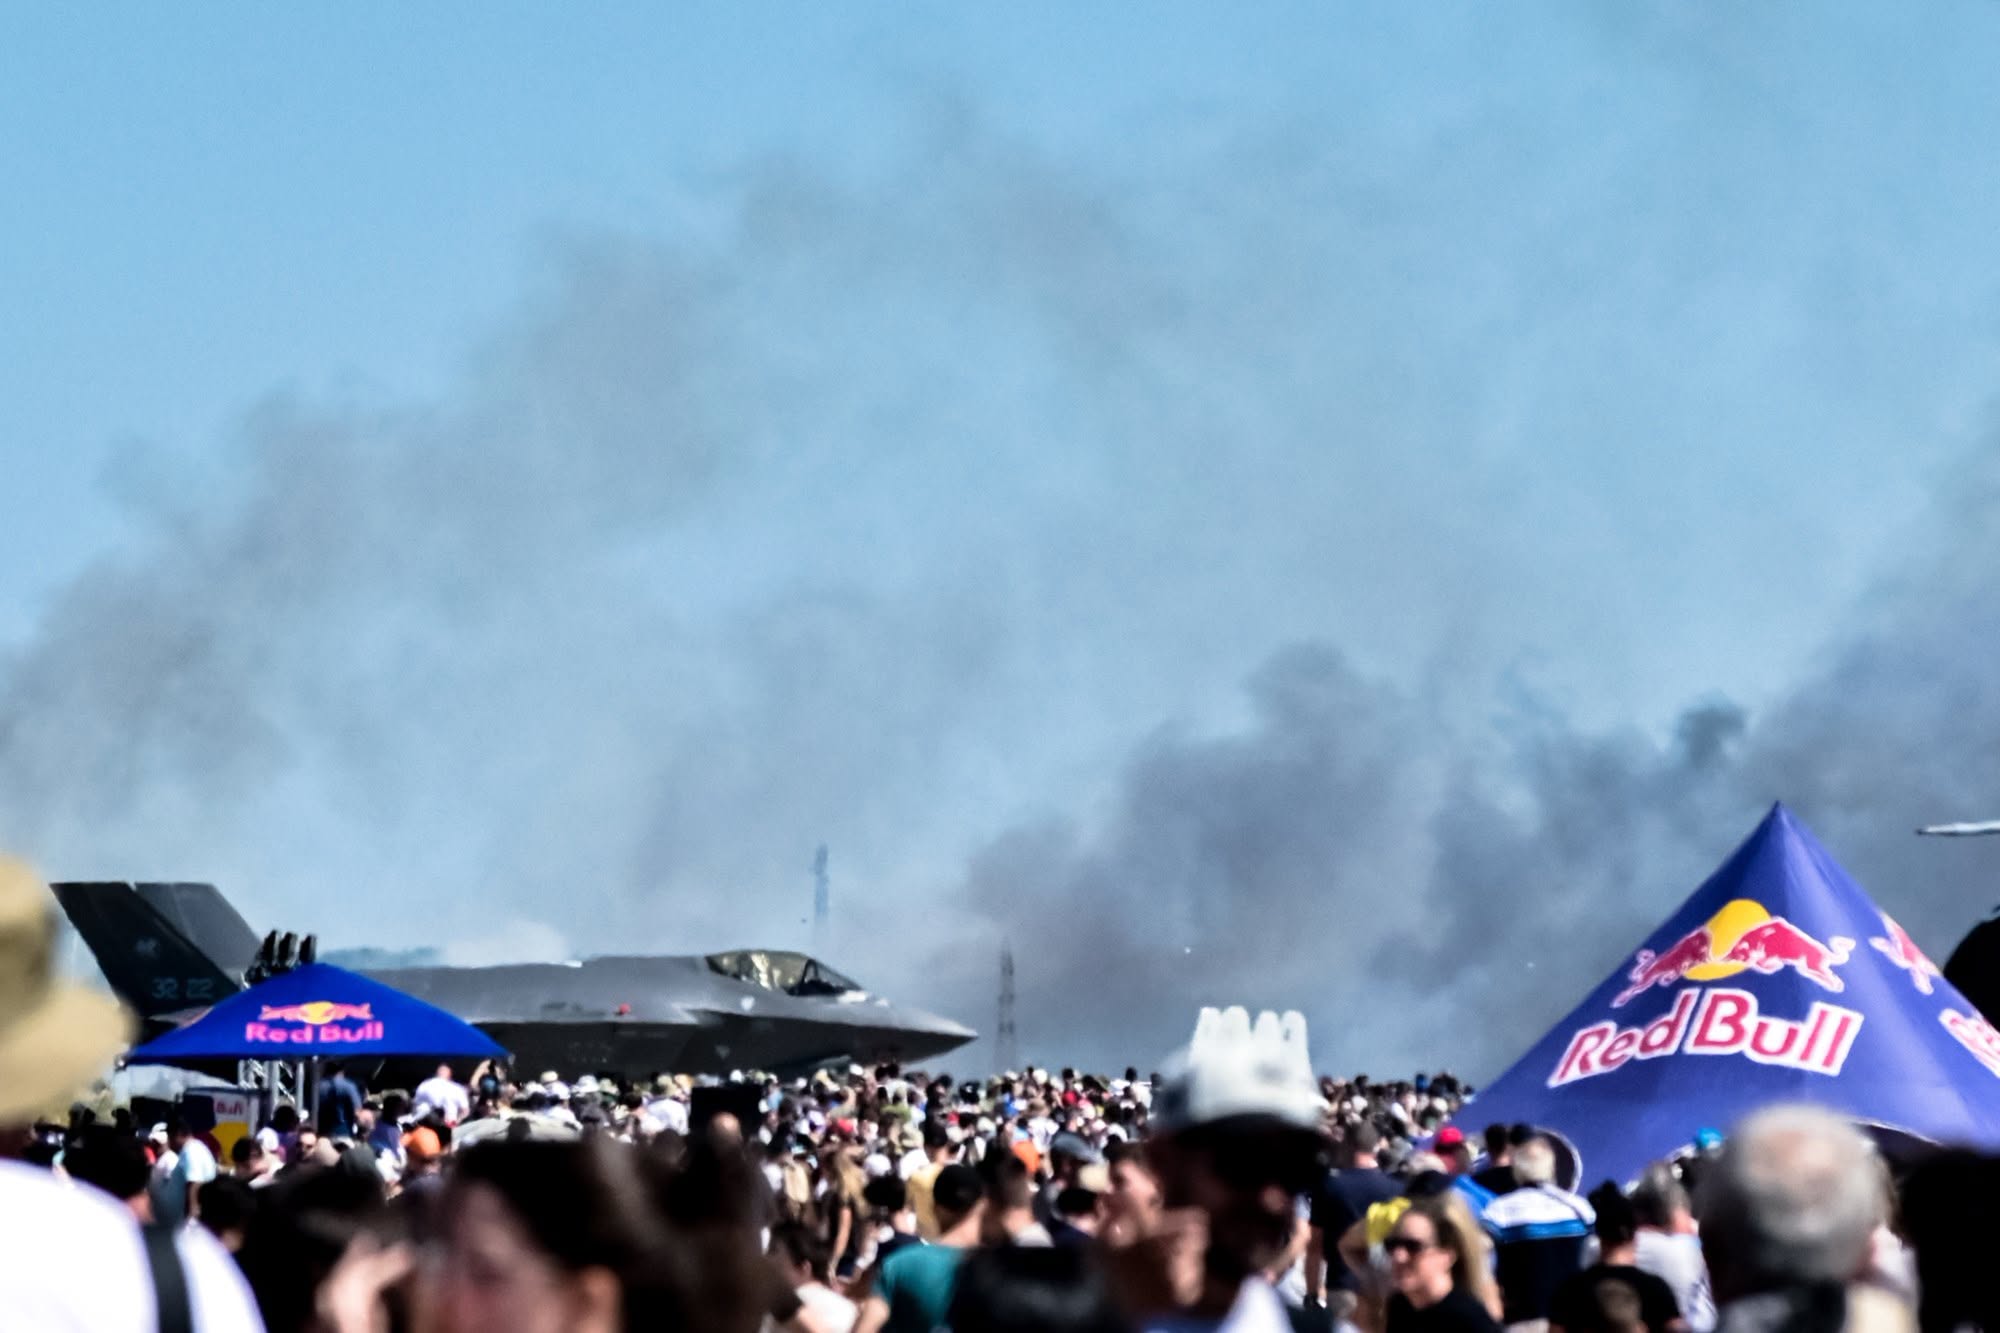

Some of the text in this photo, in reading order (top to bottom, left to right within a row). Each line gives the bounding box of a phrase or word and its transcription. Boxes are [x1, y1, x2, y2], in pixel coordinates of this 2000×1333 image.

[246, 1021, 384, 1043] Red Bull
[1549, 989, 1698, 1086] Red
[1686, 989, 1862, 1075] Bull
